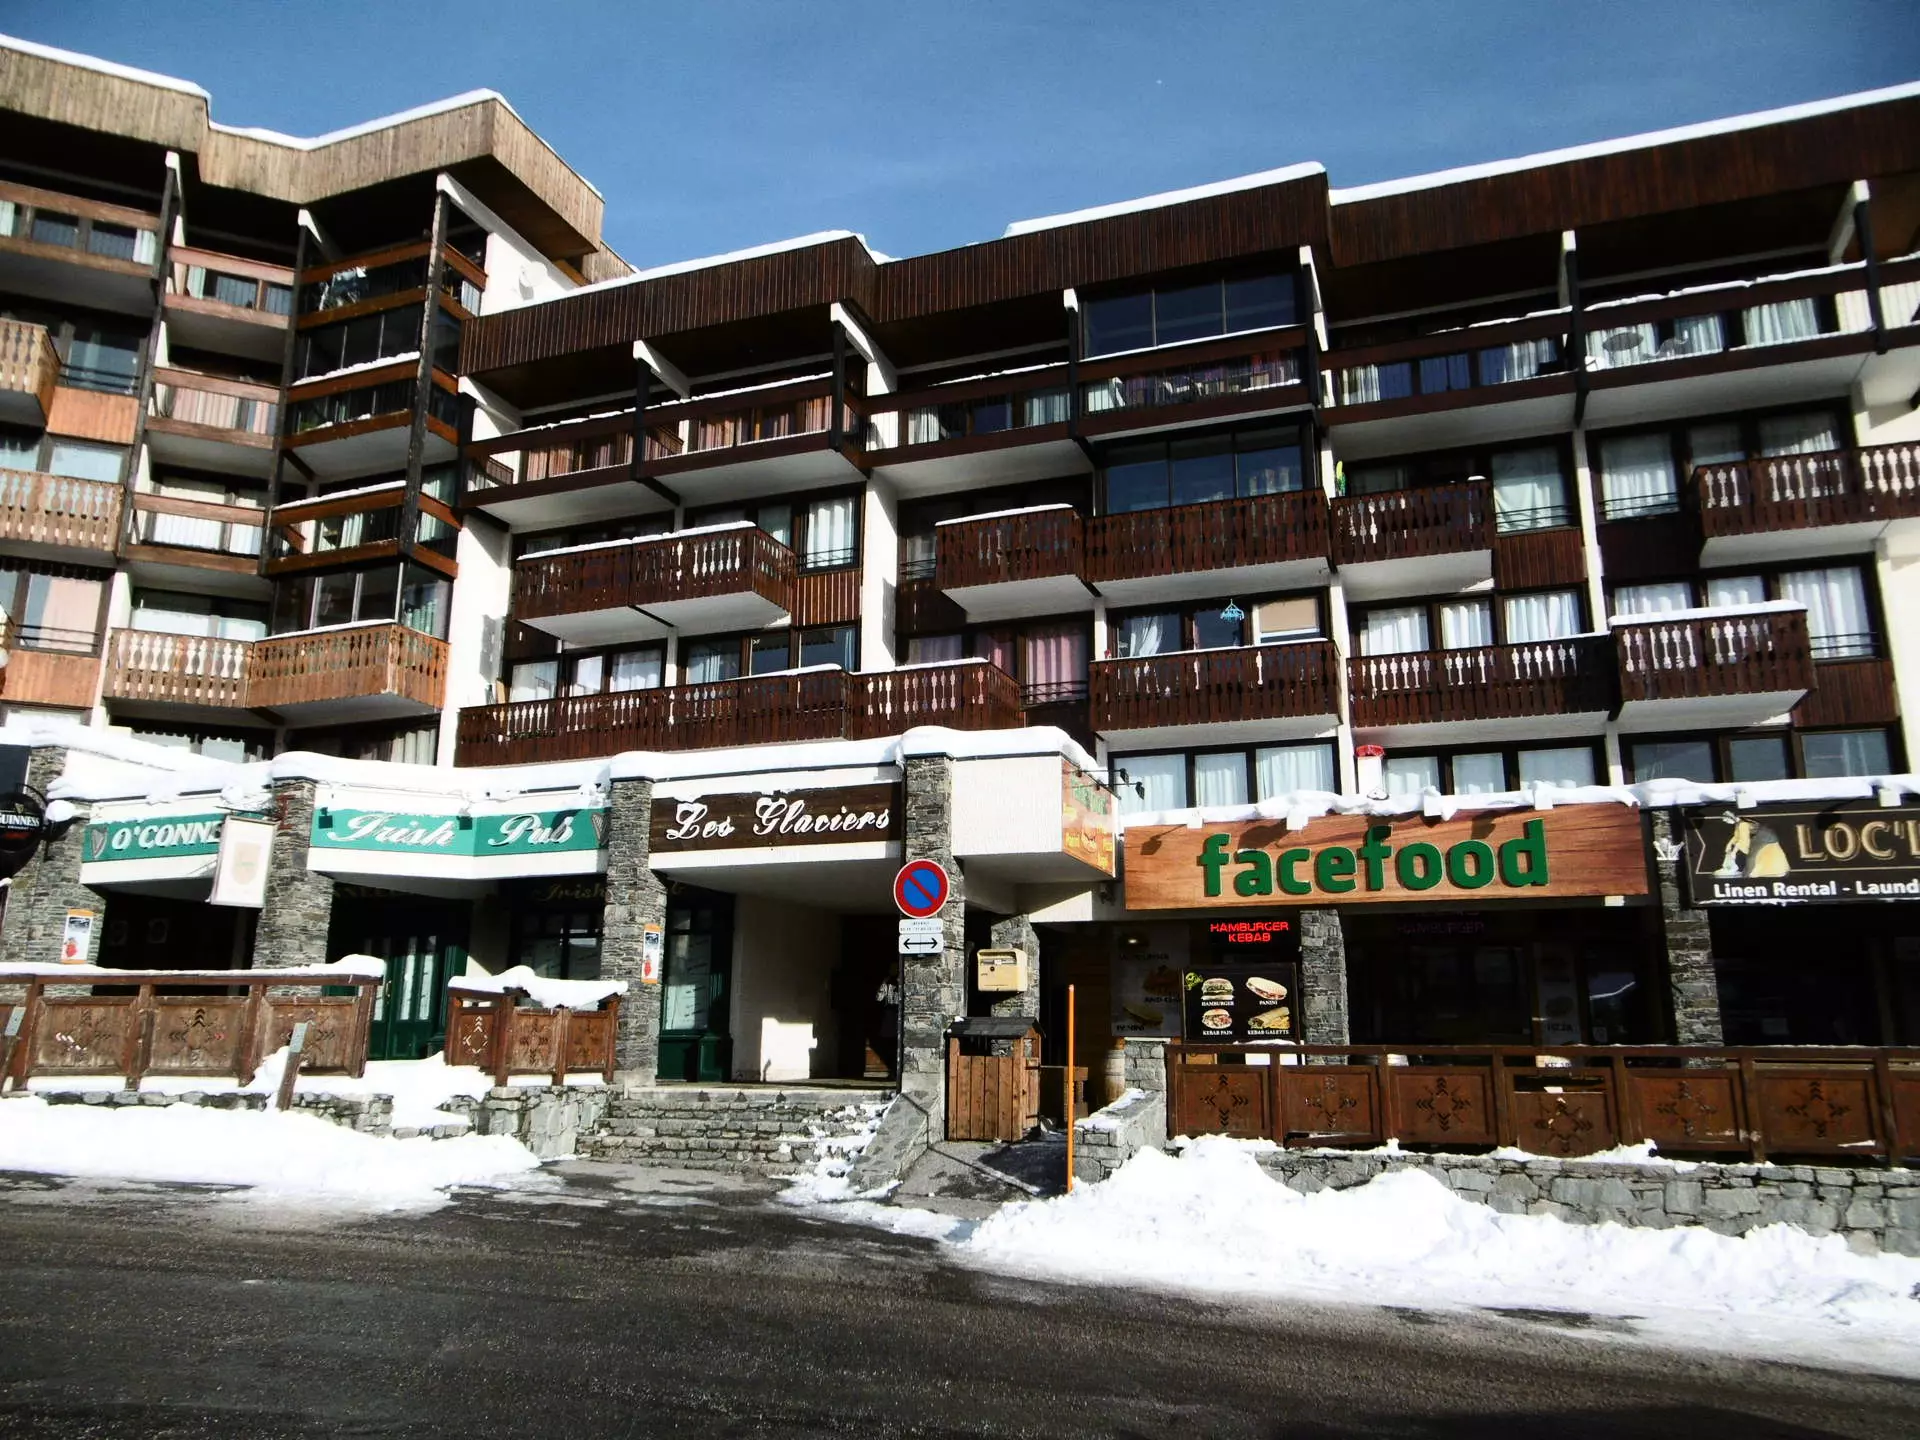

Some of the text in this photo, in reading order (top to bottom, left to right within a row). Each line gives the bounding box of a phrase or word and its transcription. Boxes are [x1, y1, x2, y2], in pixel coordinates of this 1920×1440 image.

[327, 813, 575, 848] Irish Pub
[666, 797, 891, 840] Les Glaciers
[1197, 818, 1550, 898] facefood
[1714, 883, 1768, 898] Linen
[1773, 881, 1837, 897] Rental
[1210, 921, 1289, 932] HAMBURGER
[1228, 932, 1271, 942] KEBAB
